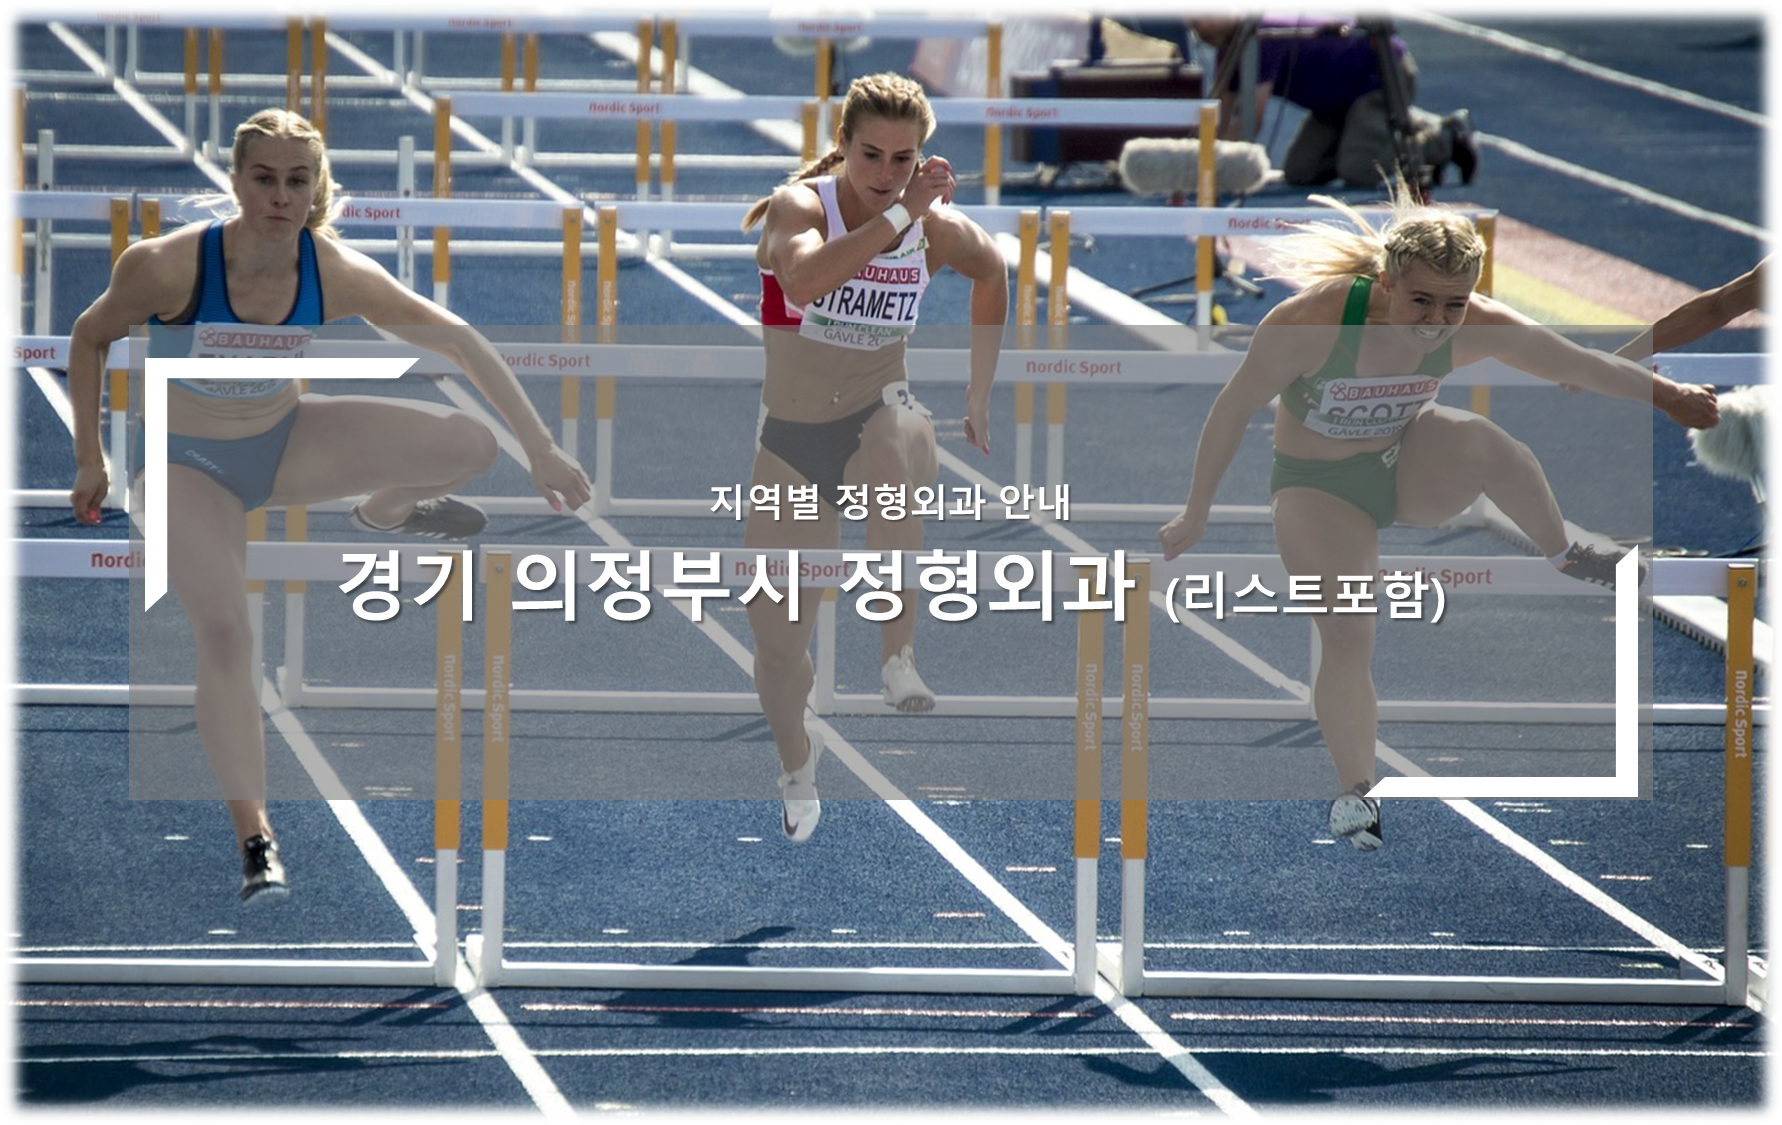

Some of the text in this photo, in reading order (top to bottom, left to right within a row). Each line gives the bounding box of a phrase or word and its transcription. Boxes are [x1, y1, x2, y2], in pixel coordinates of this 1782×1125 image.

[364, 207, 401, 221] Sport
[856, 266, 920, 283] UHAUS
[824, 327, 865, 346] GÄVLE
[12, 346, 56, 361] Sport
[548, 354, 591, 370] Sport
[1079, 361, 1122, 377] Sport
[1348, 379, 1438, 400] BAUHAUS
[1327, 426, 1372, 436] GÄVLE
[91, 552, 146, 568] nordi
[799, 562, 850, 581] Sport
[1440, 568, 1493, 588] Sport
[441, 703, 456, 742] Sport
[489, 703, 504, 742] Sport
[1082, 712, 1097, 751] Sport
[1129, 712, 1143, 752] Sport
[1732, 718, 1748, 758] Sport
